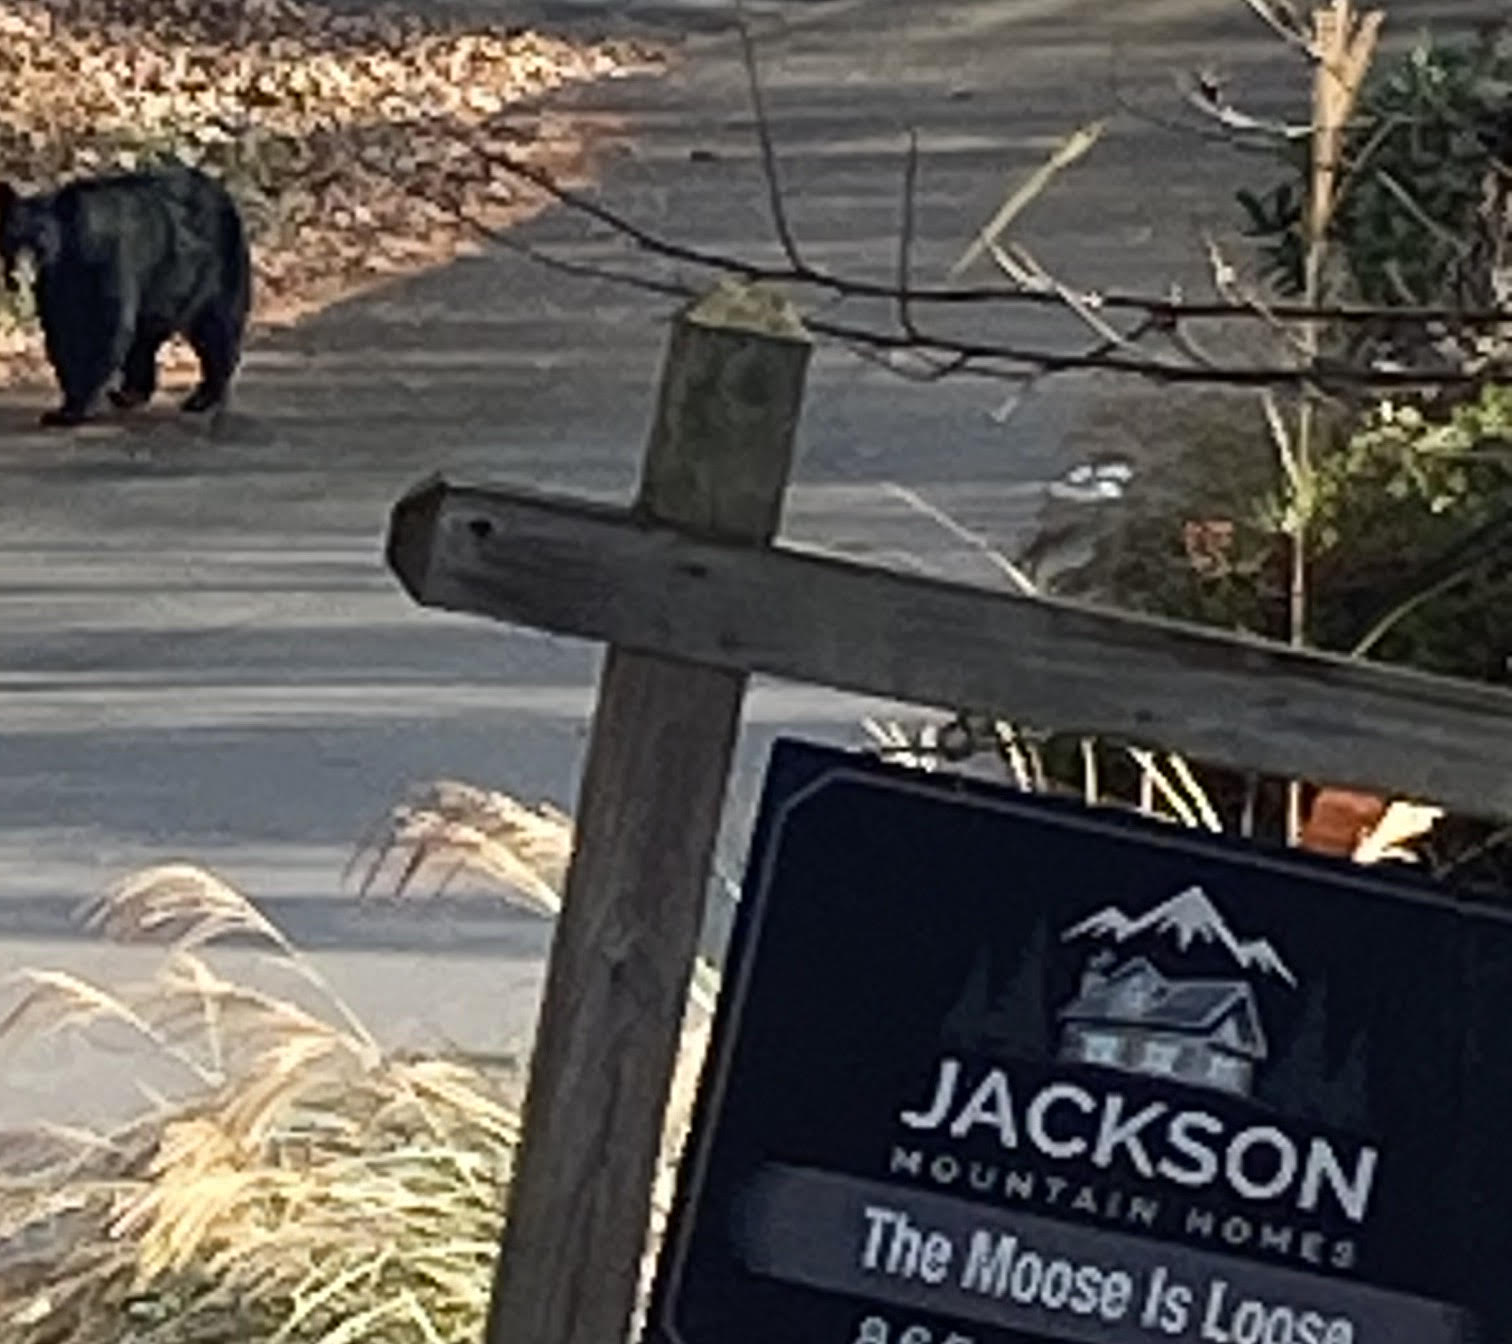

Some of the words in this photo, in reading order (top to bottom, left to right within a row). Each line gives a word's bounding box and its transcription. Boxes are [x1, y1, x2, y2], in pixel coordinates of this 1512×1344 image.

[899, 1058, 1379, 1223] JACKSON
[862, 1206, 953, 1284] The
[960, 1229, 1133, 1320] Moose
[1140, 1265, 1193, 1334] Is
[890, 1145, 1158, 1227] MOUNTAIN
[1185, 1207, 1355, 1269] HOMES
